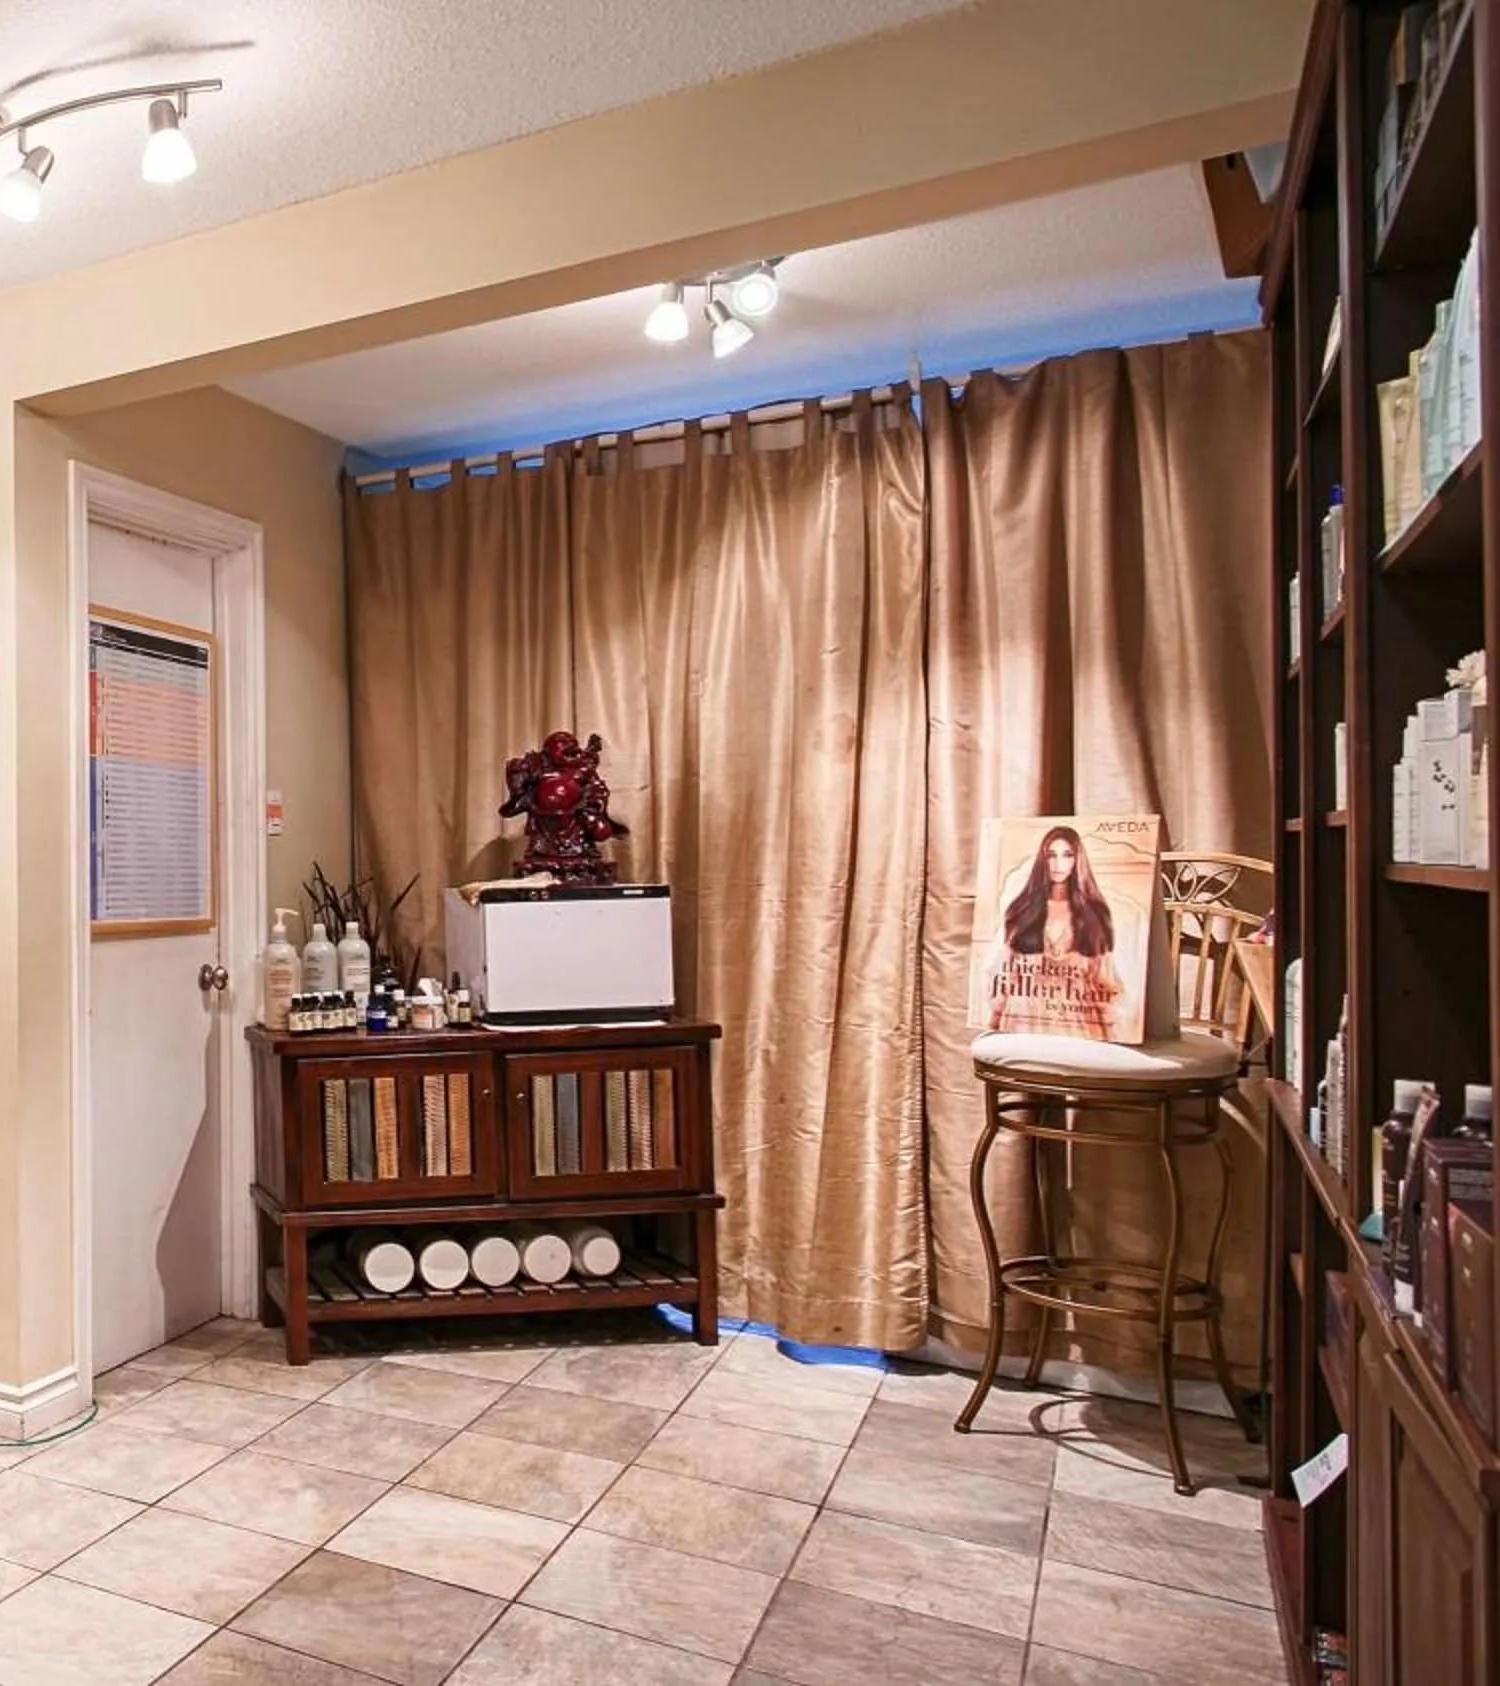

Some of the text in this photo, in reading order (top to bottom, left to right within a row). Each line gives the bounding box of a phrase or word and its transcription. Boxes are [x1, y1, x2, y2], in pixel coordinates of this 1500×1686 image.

[1095, 821, 1150, 833] AVEDA
[992, 974, 1119, 1003] fuller hair
